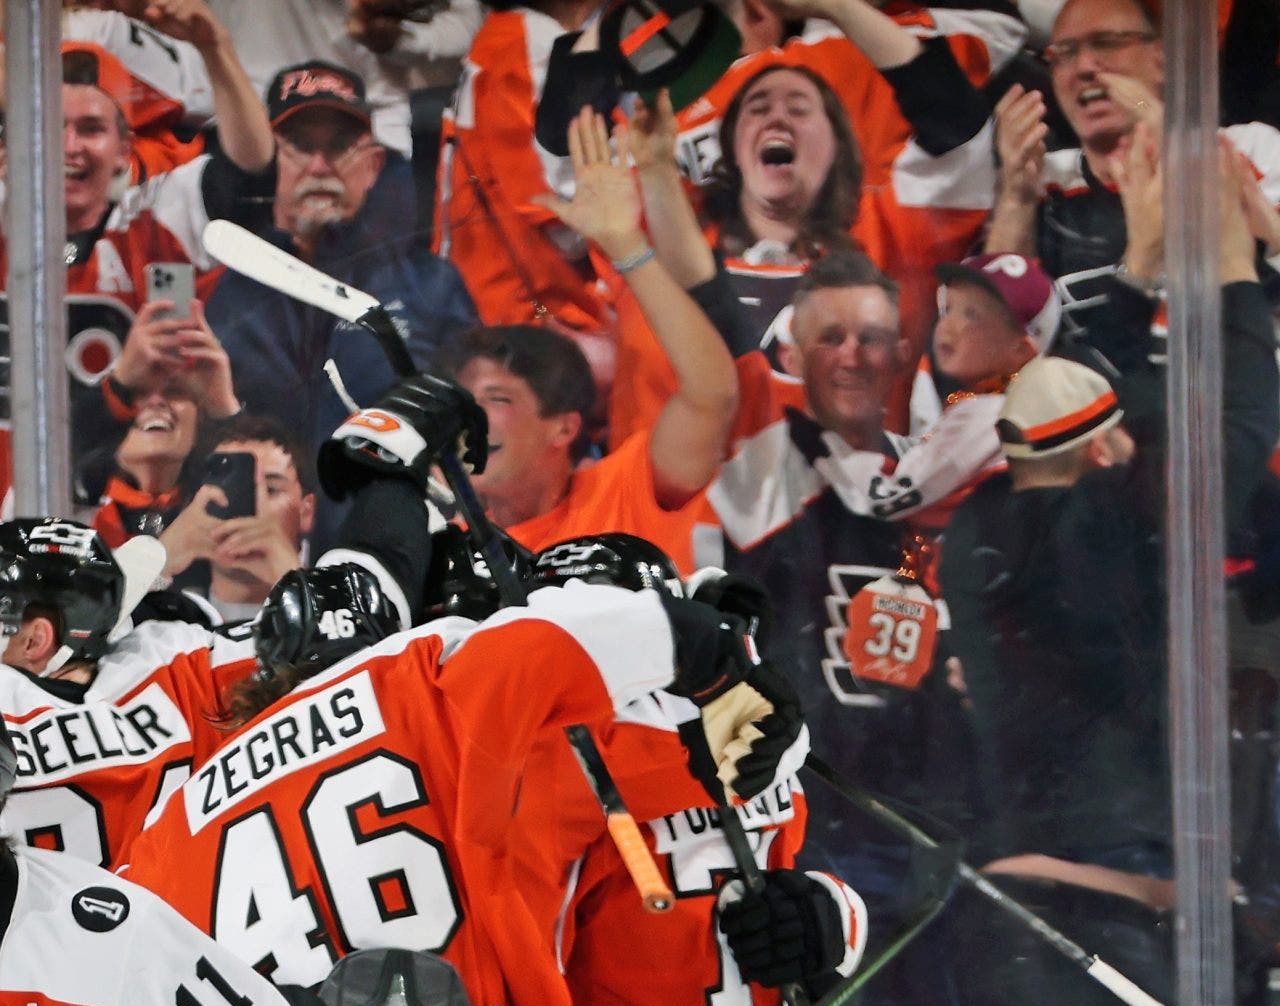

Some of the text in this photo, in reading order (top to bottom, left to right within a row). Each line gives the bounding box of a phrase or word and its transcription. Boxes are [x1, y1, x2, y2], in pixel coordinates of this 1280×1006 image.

[318, 608, 355, 640] 46
[864, 611, 922, 665] 39
[198, 687, 364, 815] ZEGRAS
[210, 747, 465, 989] 46
